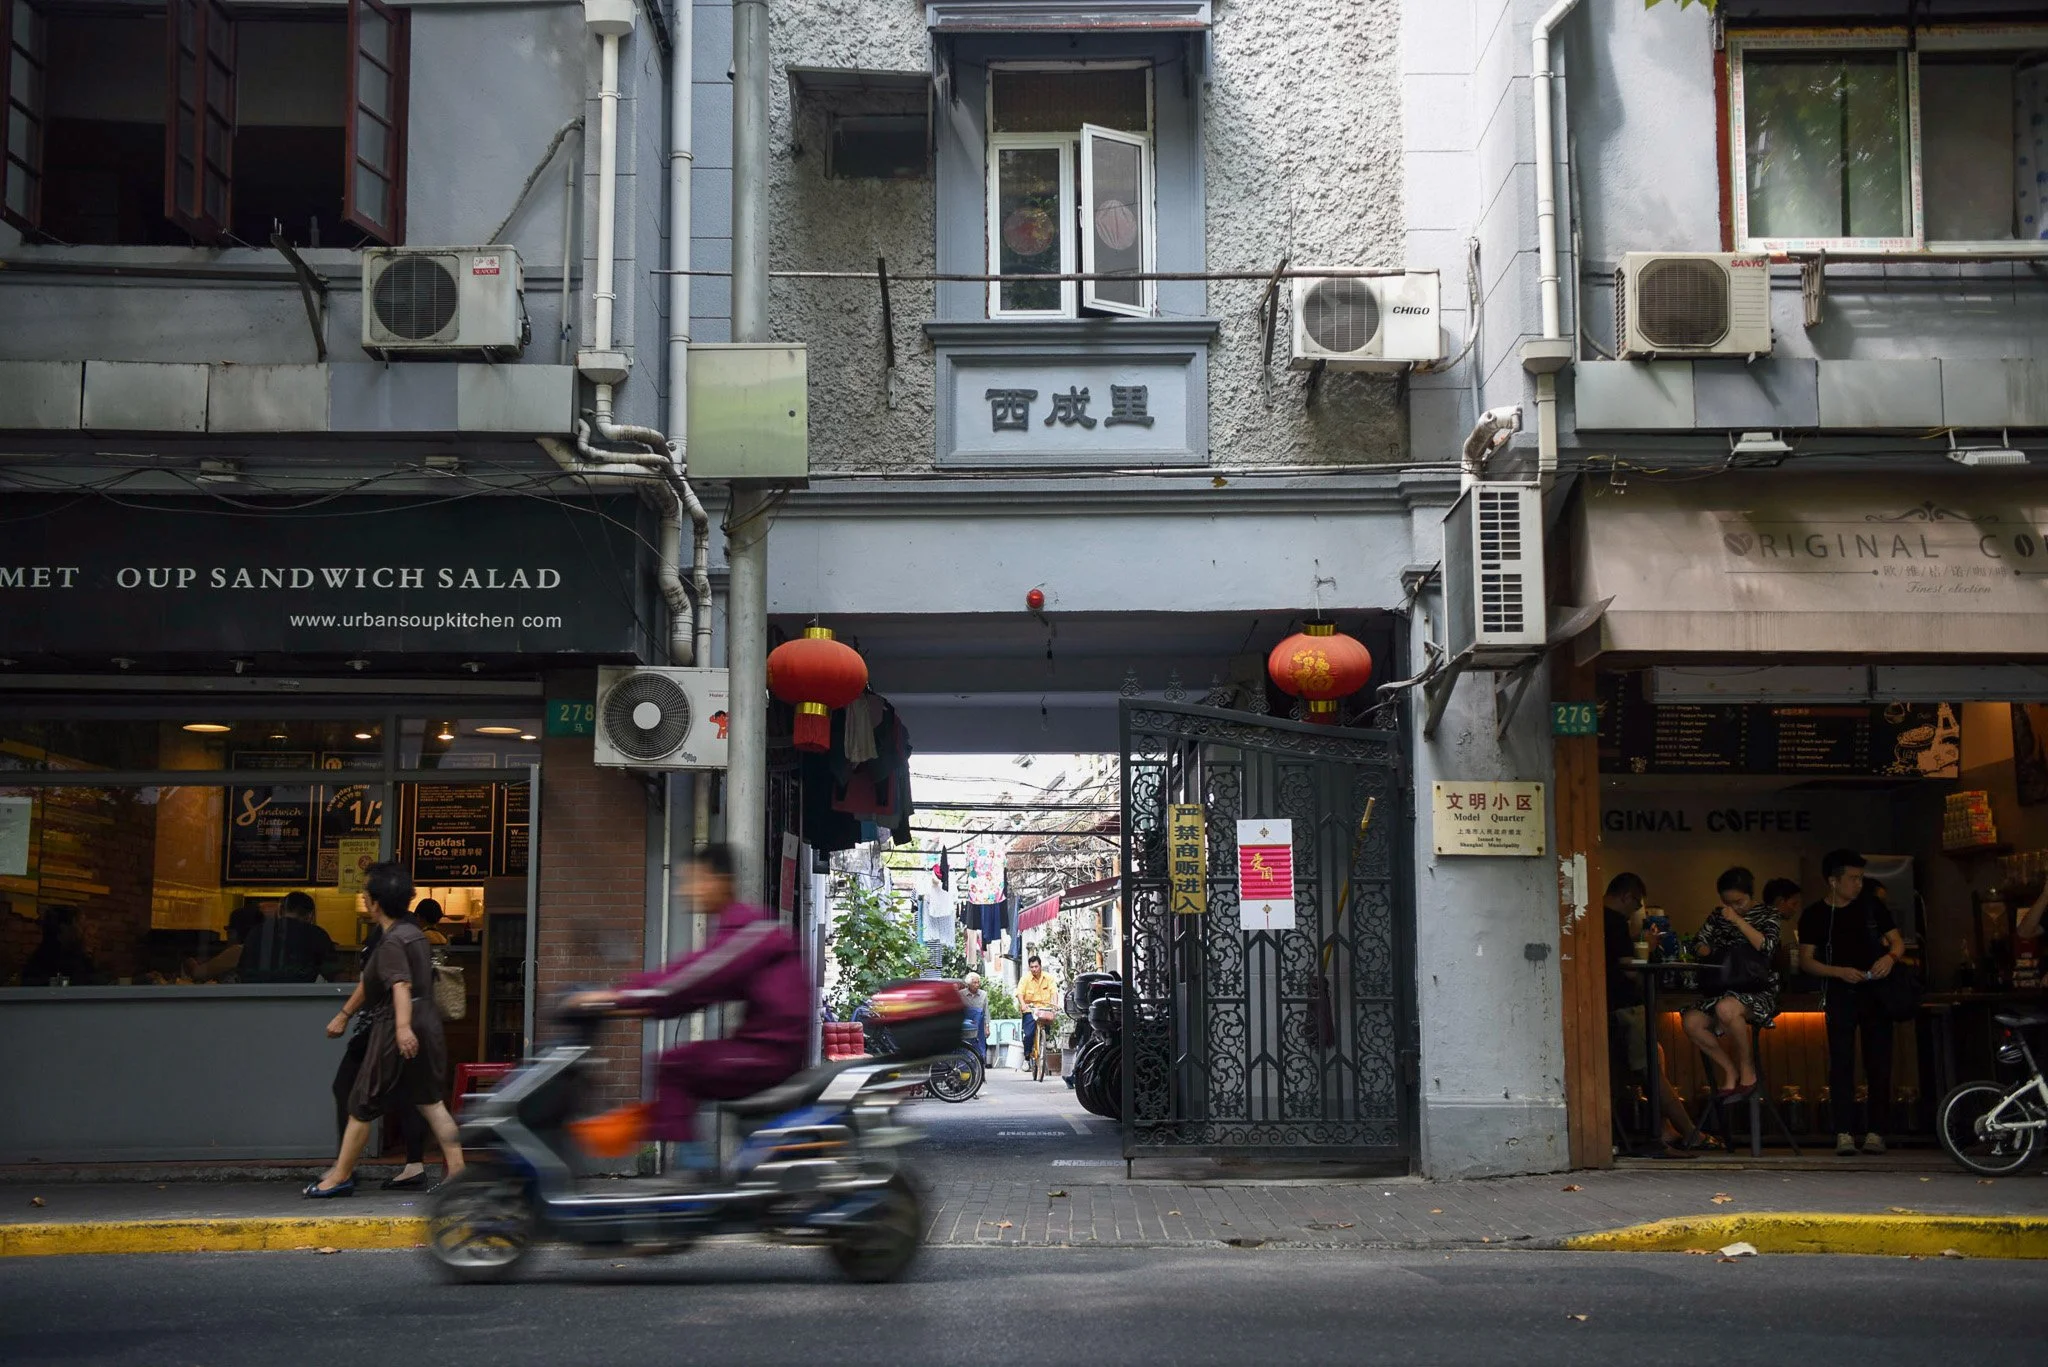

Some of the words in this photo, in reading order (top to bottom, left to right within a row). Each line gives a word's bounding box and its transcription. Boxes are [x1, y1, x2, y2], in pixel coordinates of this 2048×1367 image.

[1731, 259, 1765, 268] SANYO
[1392, 306, 1430, 315] CHIGO
[984, 384, 1155, 433] 西成里
[116, 567, 197, 588] OUP
[210, 567, 425, 588] SANDWICH
[438, 567, 561, 588] SALAD
[1906, 581, 1943, 593] Finest
[290, 612, 514, 631] www.urbansoupkitchen
[522, 616, 562, 628] com
[560, 703, 595, 721] 278
[1557, 706, 1591, 724] 276
[237, 789, 303, 827] Sandwich
[1446, 792, 1533, 811] 文明小区
[1454, 813, 1480, 822] Model
[1490, 813, 1526, 823] Quarter
[417, 838, 466, 847] Breakfast
[417, 847, 448, 856] To-Go
[1174, 807, 1202, 911] 严禁商贩进入
[1250, 852, 1274, 882] 爱国
[462, 864, 477, 876] 20
